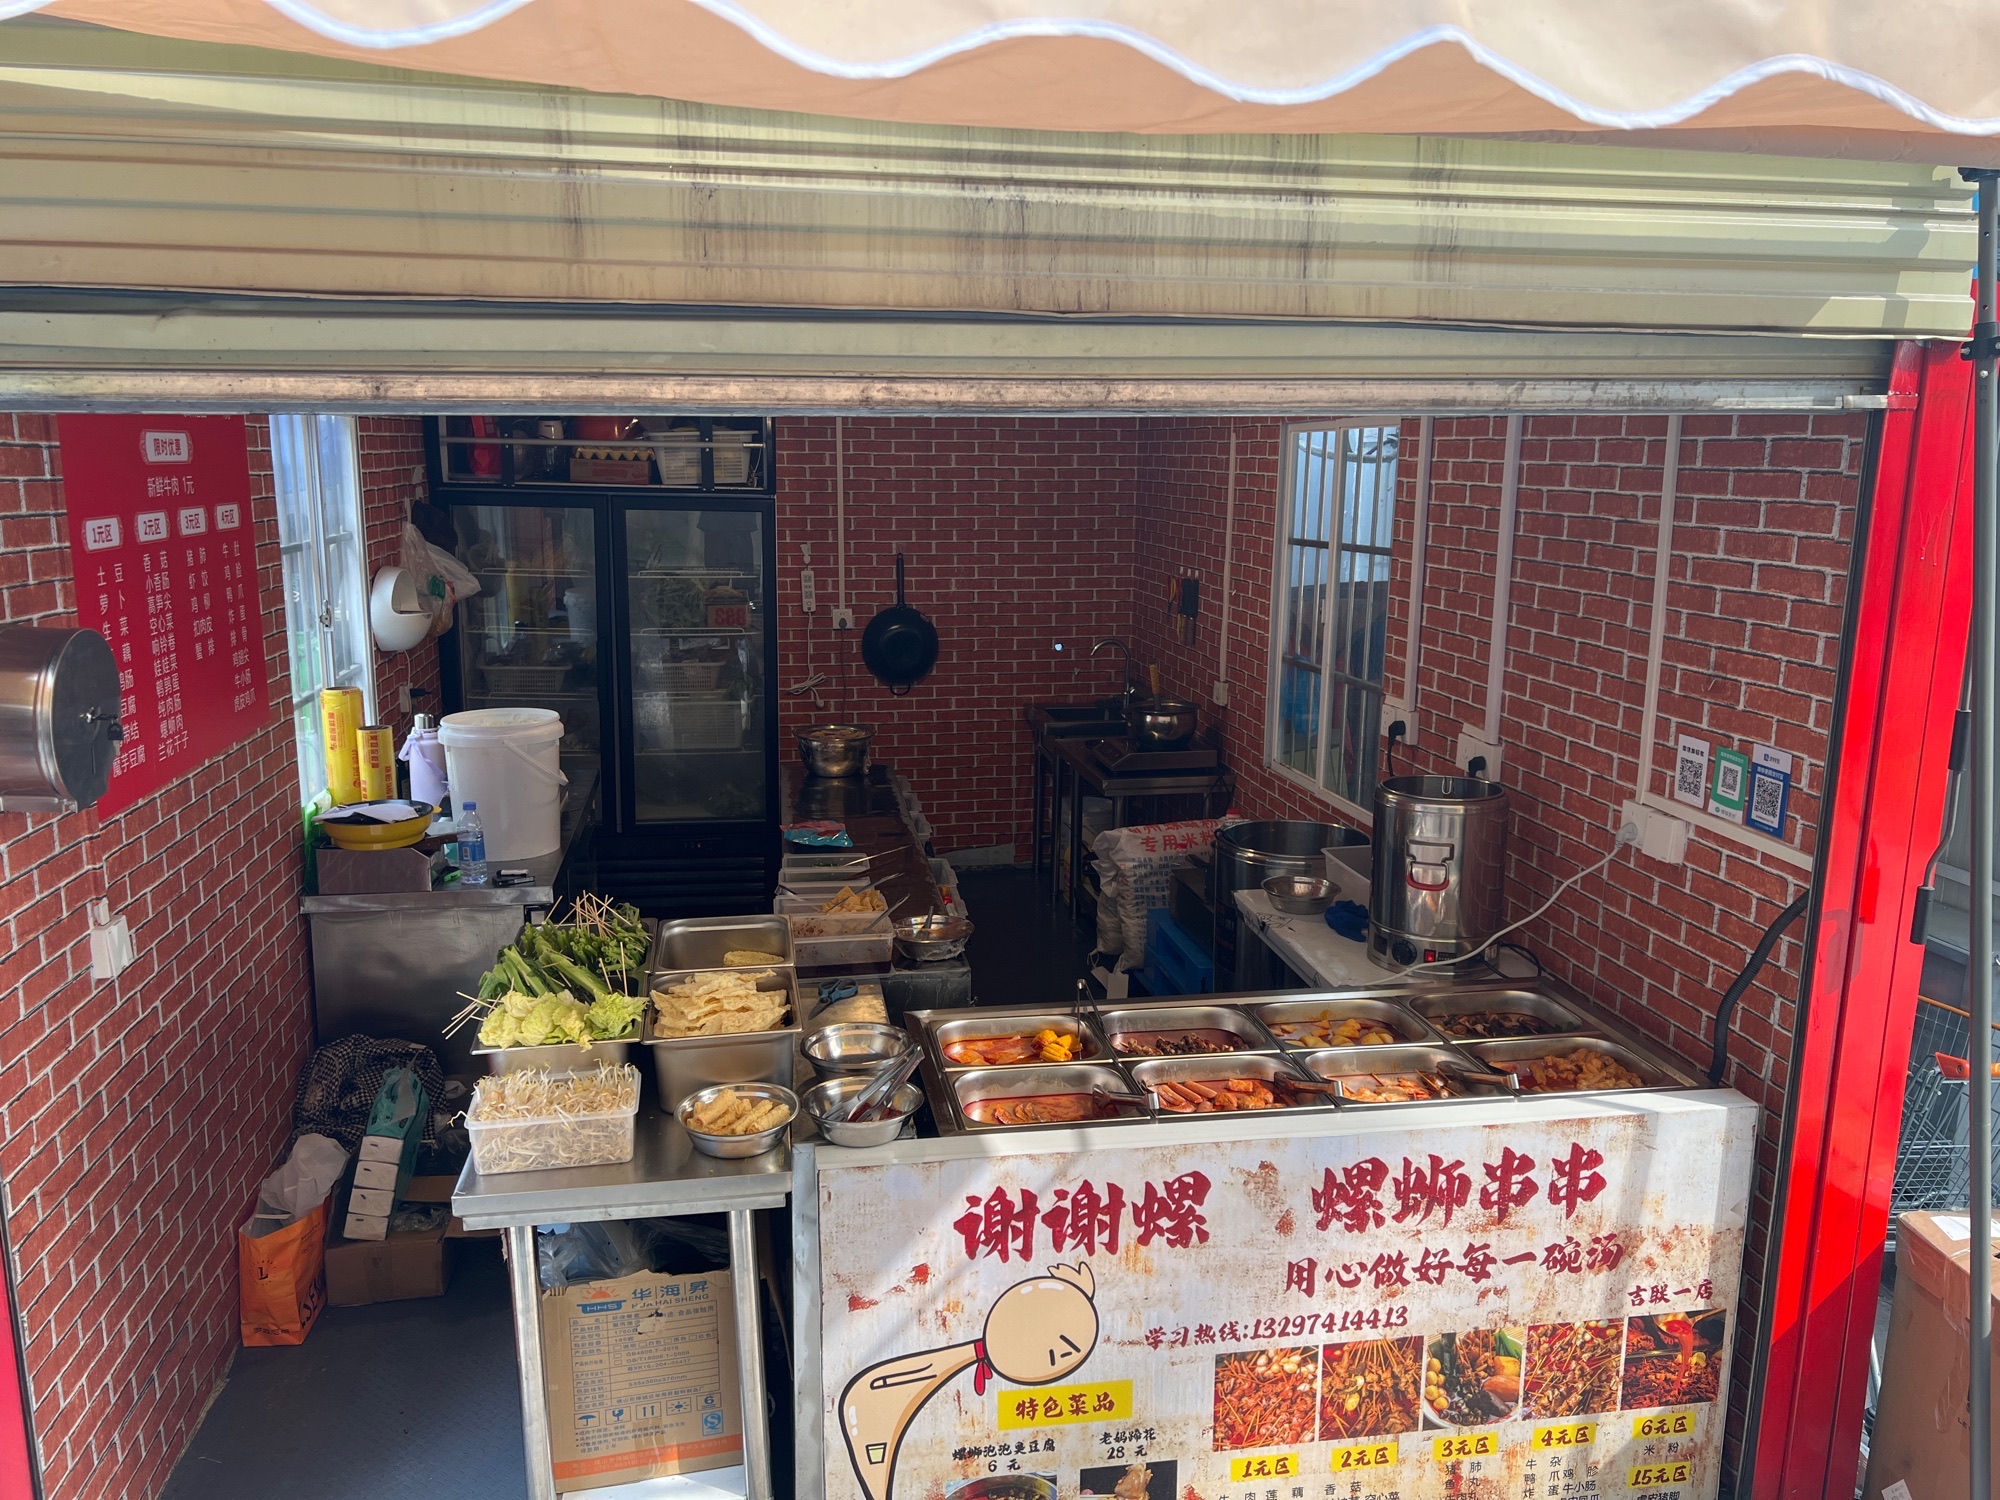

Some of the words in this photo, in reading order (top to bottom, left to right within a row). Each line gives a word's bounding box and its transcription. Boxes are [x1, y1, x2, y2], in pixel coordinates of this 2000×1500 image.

[153, 438, 182, 456] 限时优惠
[147, 477, 180, 498] 新鲜牛肉
[182, 475, 195, 495] 1元
[143, 518, 162, 536] 2元区
[184, 513, 201, 530] 3元区
[221, 509, 235, 524] 4元区
[92, 524, 113, 544] 1元区
[97, 563, 124, 587] 土豆
[146, 571, 170, 594] 小香肠
[98, 589, 126, 616] 萝卜
[149, 612, 174, 636] 空心菜
[151, 632, 176, 657] 响铃卷
[154, 653, 178, 677] 娃娃菜
[155, 672, 180, 698] 鹌鹑蛋
[235, 668, 252, 689] 牛小肠
[158, 692, 182, 718] 纯肉肠
[121, 720, 140, 746] 带结
[160, 714, 184, 739] 螺蛳肉
[158, 730, 189, 762] 兰花干子
[112, 744, 146, 778] 魔芋豆腐
[1140, 829, 1214, 853] 专用米粉
[953, 1170, 1212, 1263] 谢谢螺
[1311, 1142, 1608, 1234] 螺蛳串串
[258, 1266, 269, 1281] L
[1284, 1233, 1626, 1298] 用心做好每一碗汤
[655, 1299, 672, 1307] HAI
[674, 1294, 709, 1304] SHENG
[1627, 1279, 1714, 1307] 吉联一店
[586, 1303, 618, 1312] HHS
[704, 1396, 715, 1405] 6
[1015, 1391, 1116, 1422] 特色菜品
[1099, 1427, 1157, 1445] 老妈蹄花
[1641, 1415, 1687, 1436] 6元区
[1441, 1436, 1490, 1458] 3元区
[1540, 1426, 1590, 1448] 4元区
[951, 1437, 1056, 1461] 螺蛳泡泡臭豆腐
[1107, 1445, 1125, 1459] 28
[1134, 1443, 1148, 1457] 元
[1340, 1446, 1390, 1468] 2元区
[1643, 1442, 1680, 1455] 米粉
[987, 1459, 998, 1472] 6
[1007, 1457, 1021, 1472] 元
[1241, 1456, 1290, 1479] 1元区
[1631, 1464, 1687, 1486] 15元区
[1562, 1480, 1597, 1493] 牛小肠
